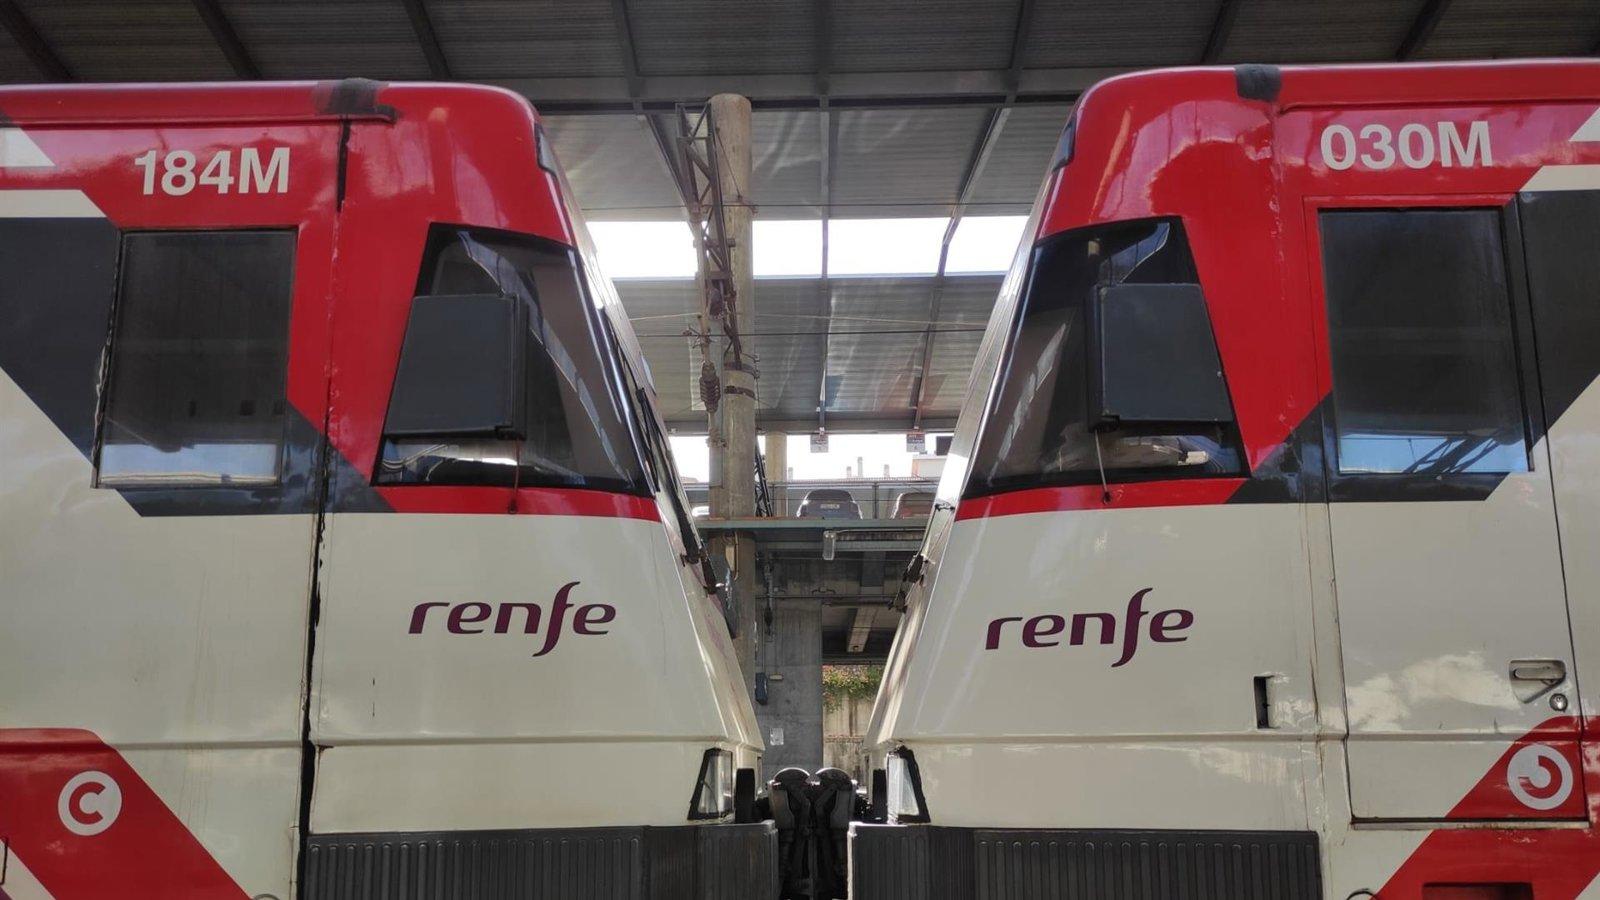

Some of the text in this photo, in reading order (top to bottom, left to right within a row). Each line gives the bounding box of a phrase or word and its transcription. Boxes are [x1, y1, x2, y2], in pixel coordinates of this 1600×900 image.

[134, 147, 291, 196] 184M
[1320, 120, 1493, 171] 030M
[408, 581, 617, 657] renfe
[985, 588, 1194, 668] renfe
